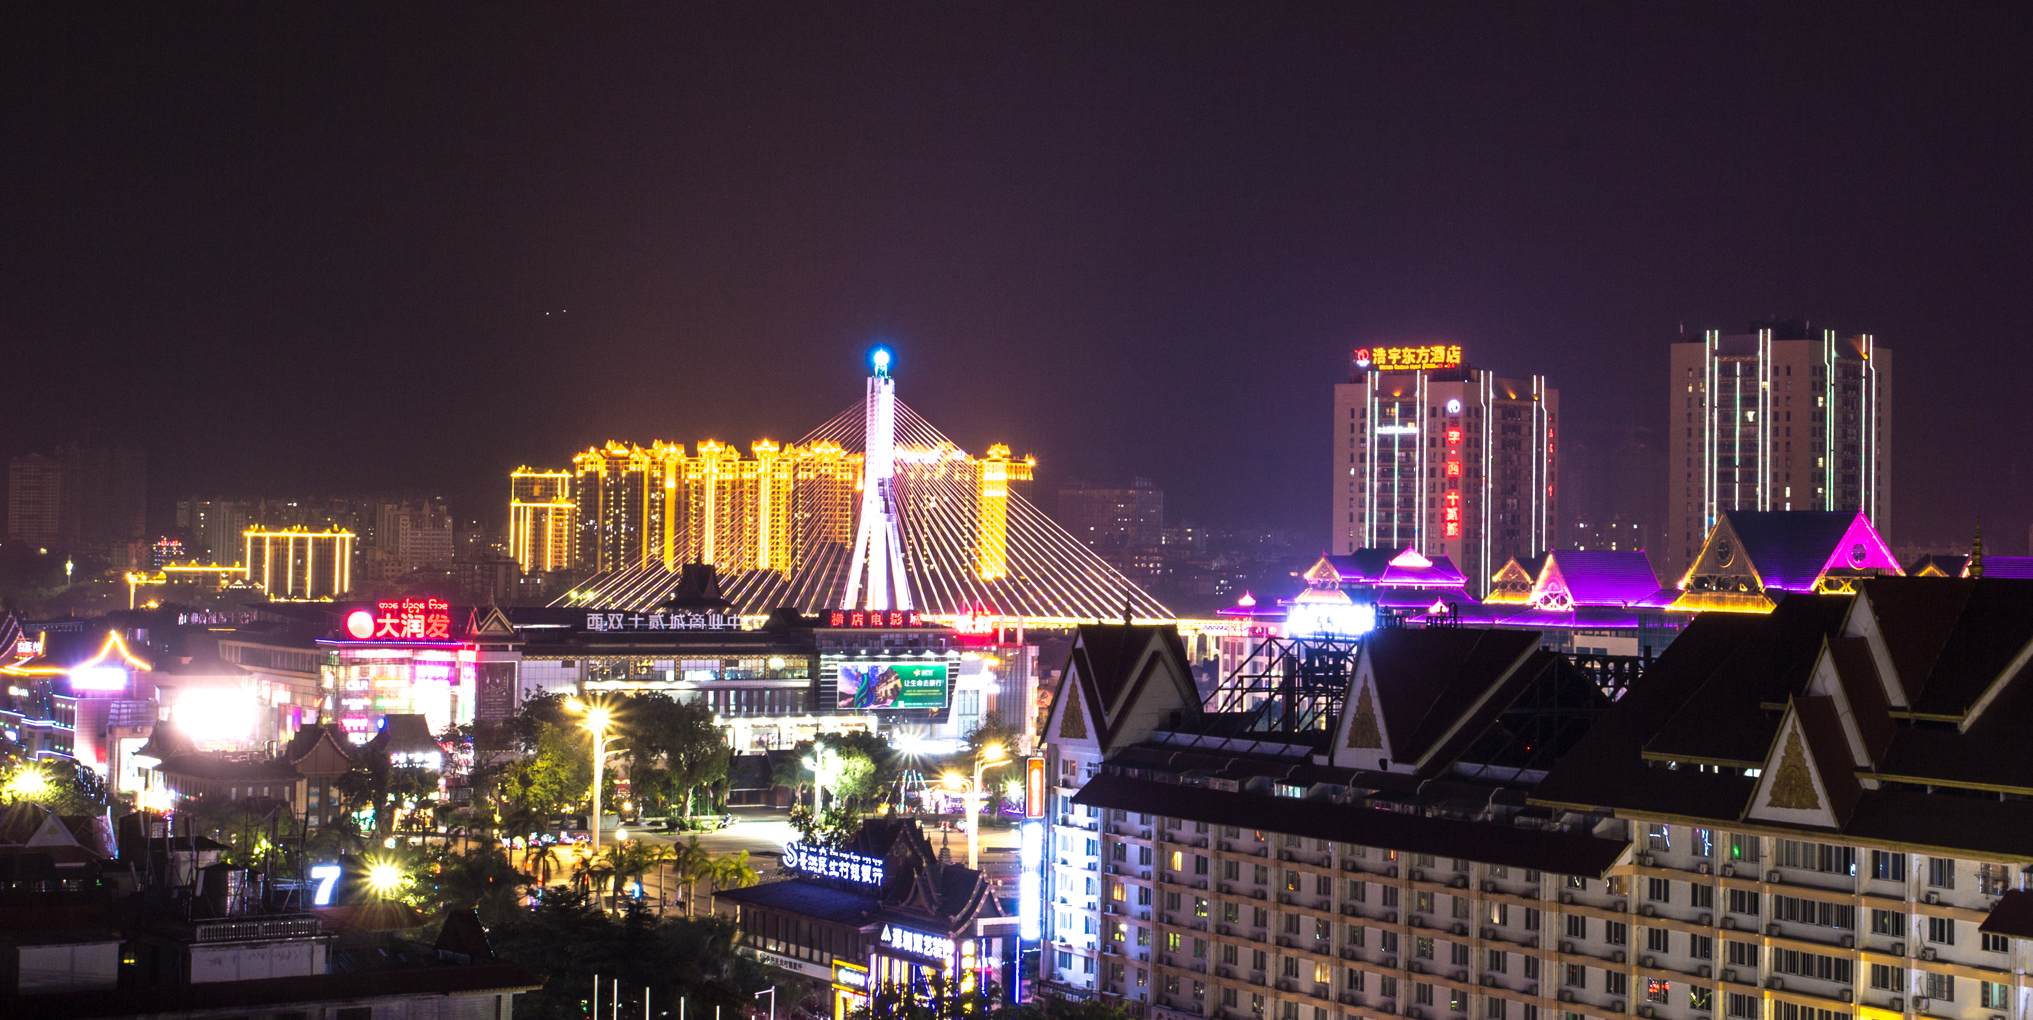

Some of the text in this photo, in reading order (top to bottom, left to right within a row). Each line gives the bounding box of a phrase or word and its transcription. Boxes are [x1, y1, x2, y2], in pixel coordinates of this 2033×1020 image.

[1372, 345, 1462, 364] 浩宇东方酒店
[376, 612, 450, 638] 大润发
[586, 613, 764, 631] 西双十贰城商业中
[831, 612, 923, 627] 横店电影城
[311, 866, 341, 905] 7
